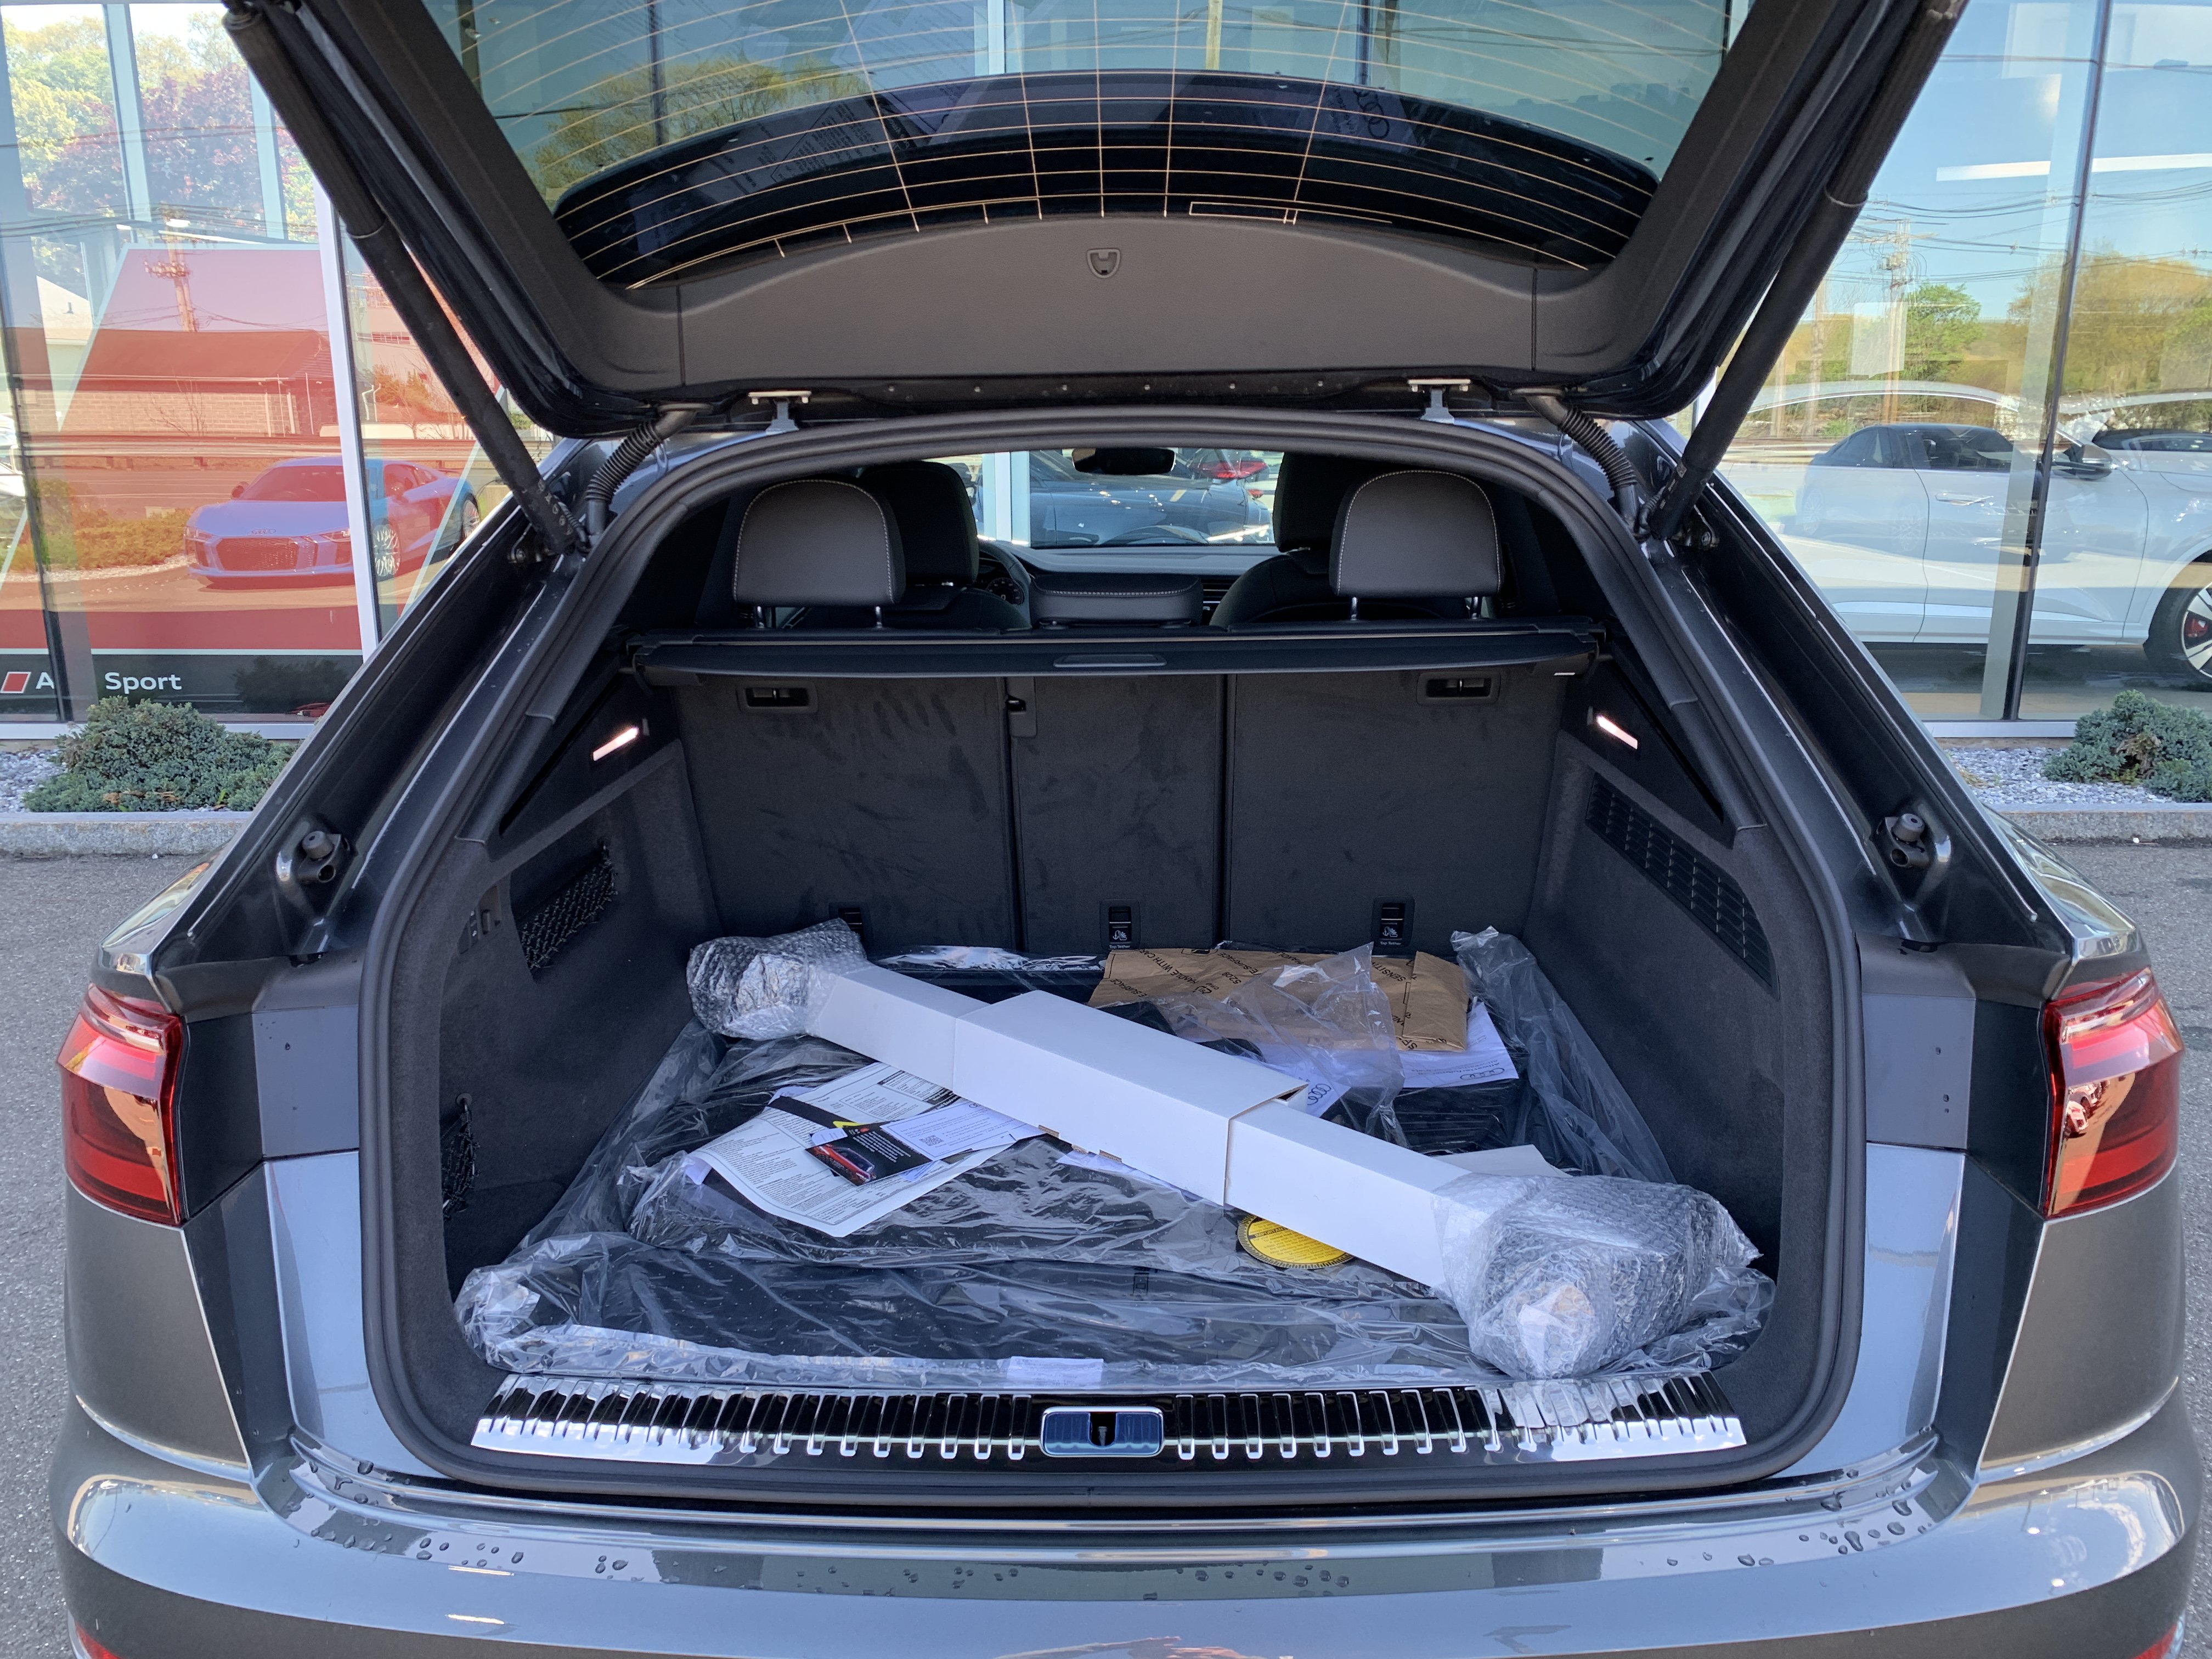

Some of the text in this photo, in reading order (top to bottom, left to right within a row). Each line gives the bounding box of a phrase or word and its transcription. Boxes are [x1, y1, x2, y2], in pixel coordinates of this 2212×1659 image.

[105, 672, 183, 694] Sport
[1139, 949, 1200, 984] HANDLE WITH CAR
